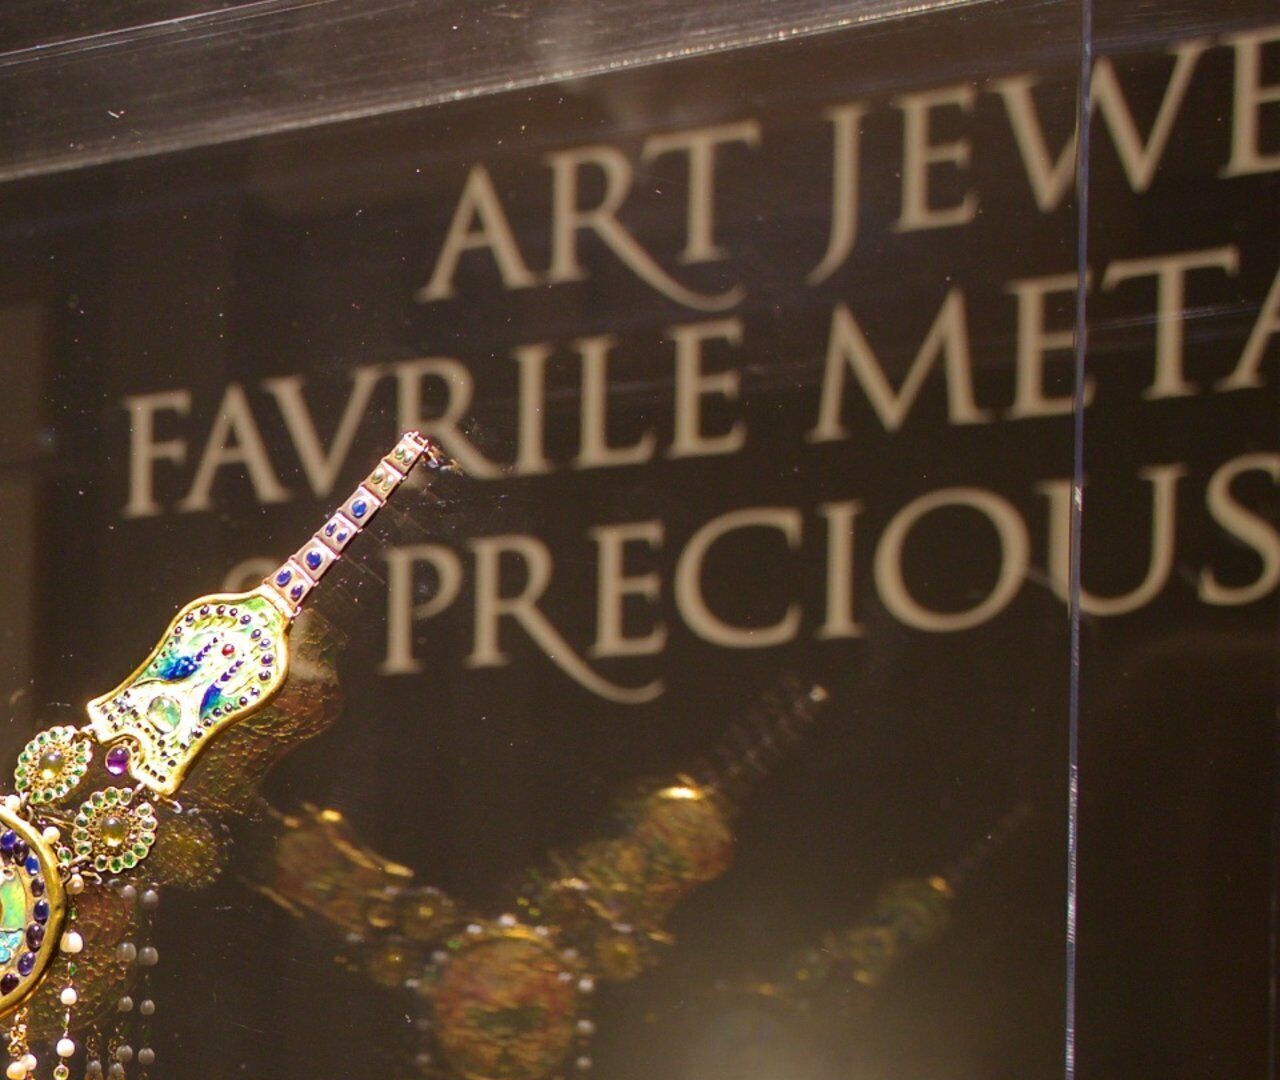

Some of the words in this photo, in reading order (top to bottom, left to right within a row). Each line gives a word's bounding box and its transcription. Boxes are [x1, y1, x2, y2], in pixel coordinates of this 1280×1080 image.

[419, 121, 760, 311] ART
[123, 317, 746, 518] FAVRILE
[378, 453, 1280, 705] PRECIOUS
